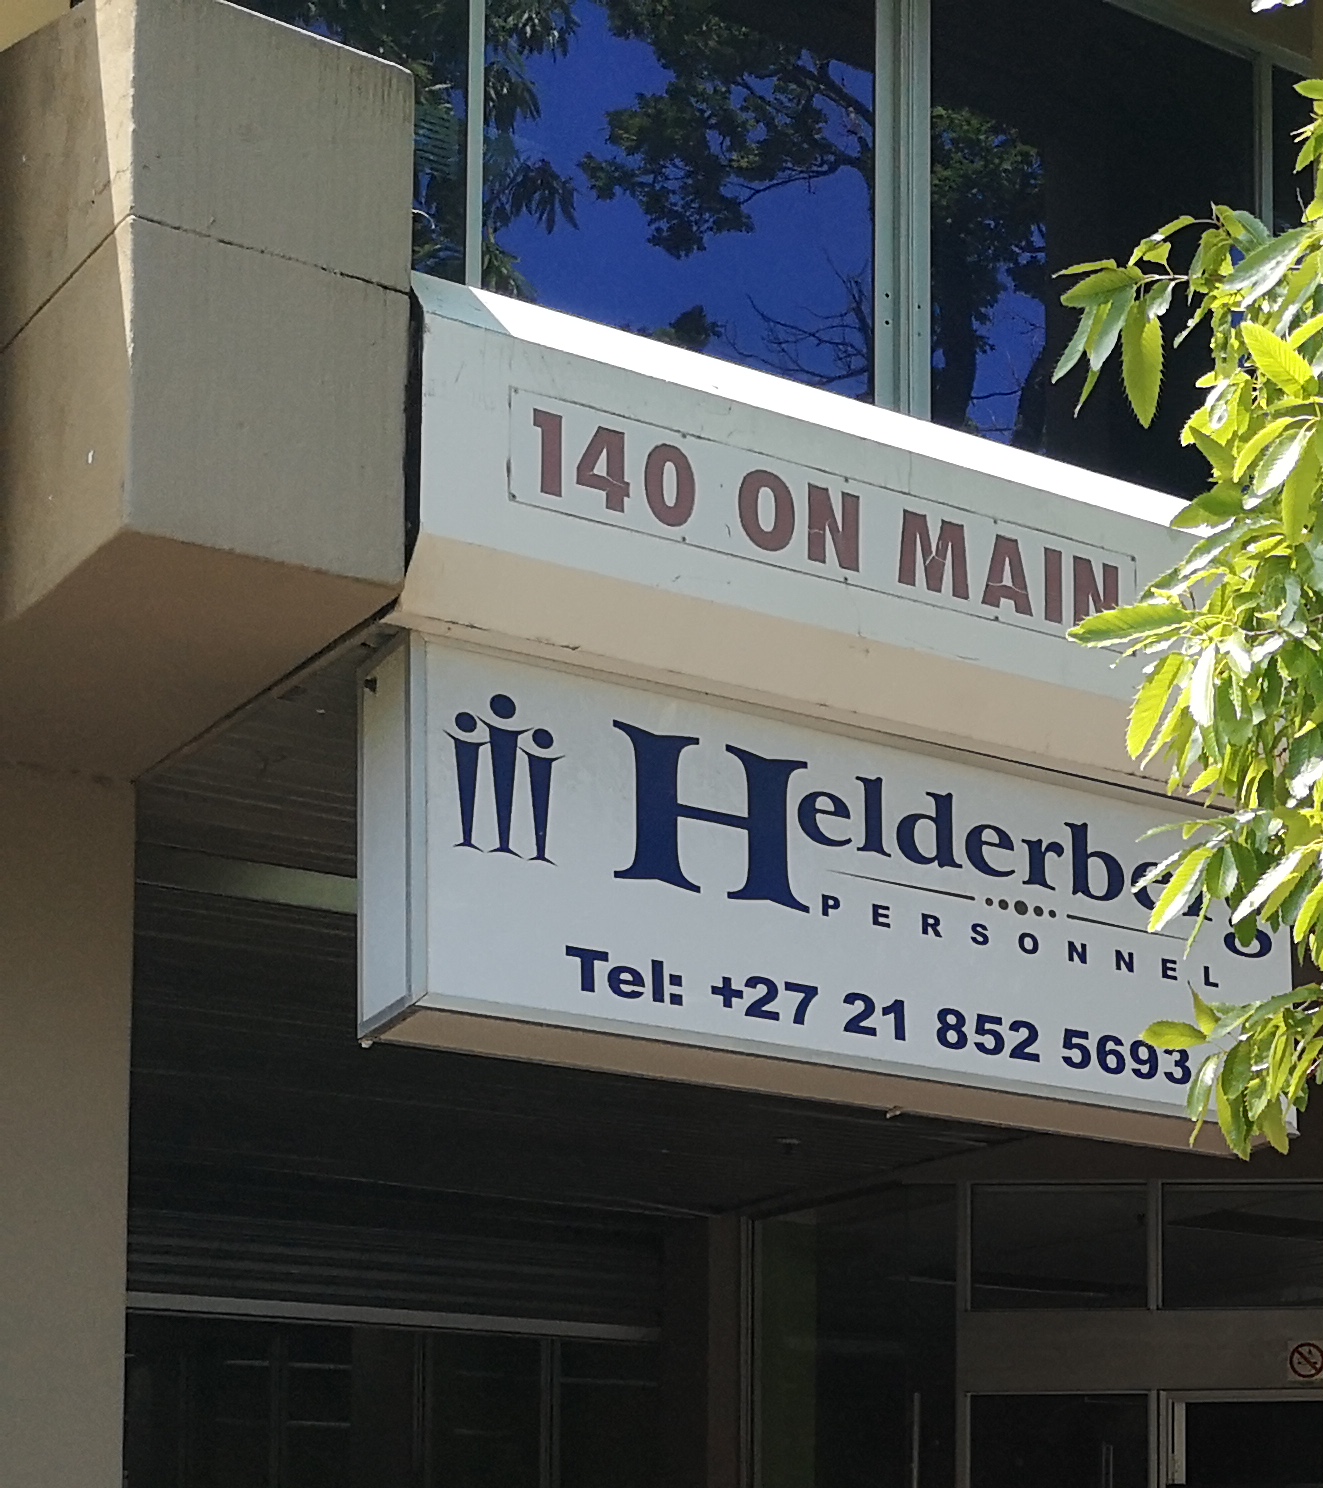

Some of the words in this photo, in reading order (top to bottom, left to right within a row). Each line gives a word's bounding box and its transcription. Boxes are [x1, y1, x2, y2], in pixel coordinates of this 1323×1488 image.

[533, 407, 696, 528] 140
[738, 469, 860, 573] ON
[897, 508, 1121, 628] MAIN
[613, 718, 1273, 958] Helderbe
[565, 945, 684, 1006] Tel:
[710, 975, 819, 1026] +27
[843, 991, 908, 1042] 21
[936, 1007, 1042, 1064] 852
[1061, 1028, 1192, 1086] 5693
[821, 893, 1219, 988] PERSONNEL
